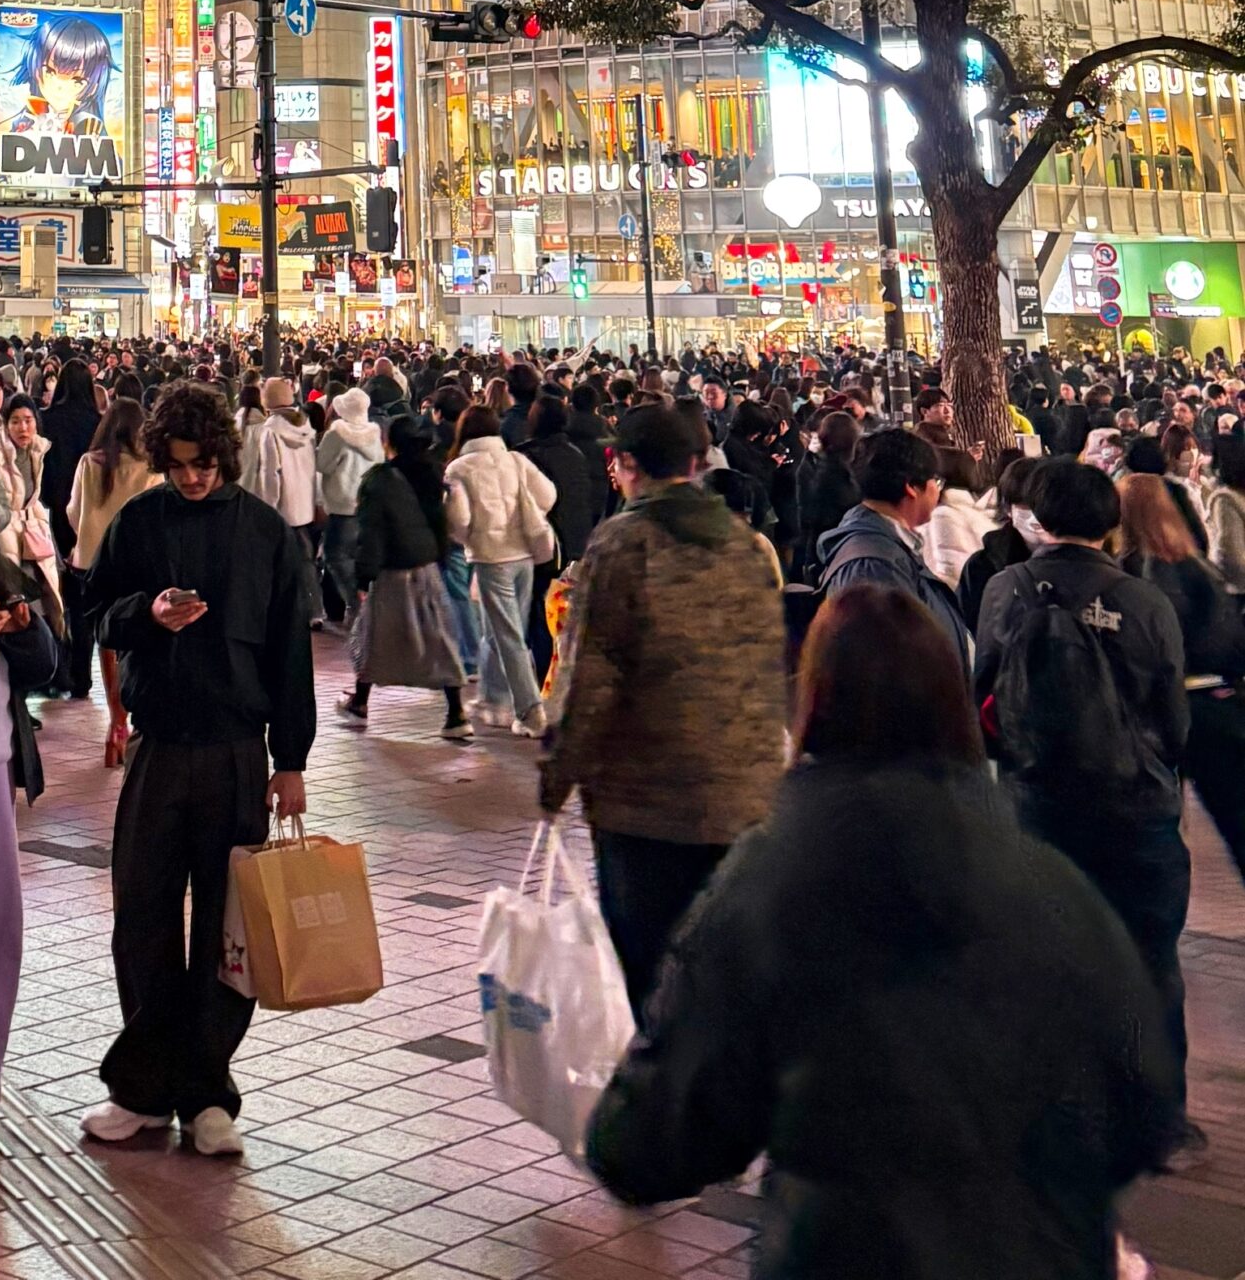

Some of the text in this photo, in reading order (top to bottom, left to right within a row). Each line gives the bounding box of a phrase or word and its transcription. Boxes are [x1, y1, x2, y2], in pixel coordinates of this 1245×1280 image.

[375, 31, 394, 122] カラオケ
[2, 136, 119, 176] DMM
[833, 199, 931, 217] TSUAY
[1022, 317, 1038, 325] B1F
